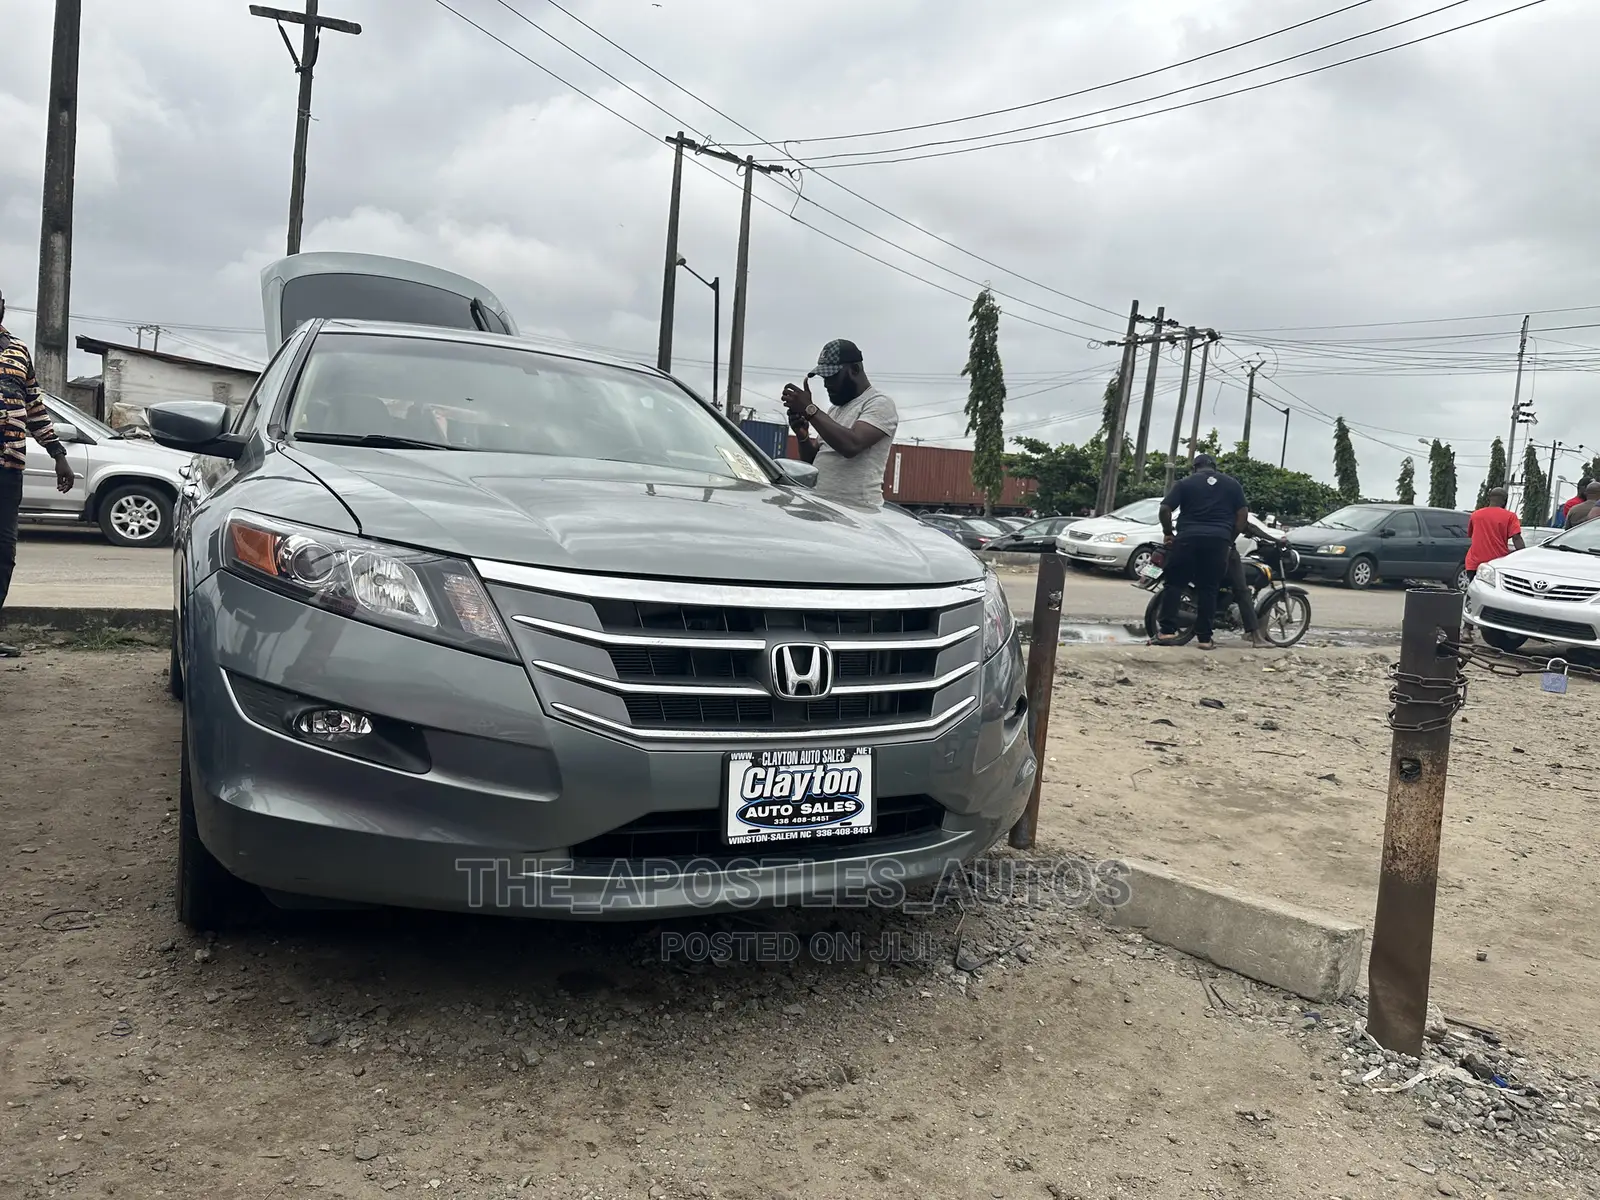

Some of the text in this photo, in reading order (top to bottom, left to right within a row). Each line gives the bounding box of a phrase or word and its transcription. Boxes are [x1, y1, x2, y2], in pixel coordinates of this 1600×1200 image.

[762, 750, 798, 766] CLAYTON
[800, 749, 820, 764] AUTO
[822, 748, 846, 763] SALES
[741, 765, 861, 802] Clayton
[745, 801, 856, 818] AUTO SALES
[729, 832, 798, 845] WINSTON-SALEM
[800, 831, 812, 839] NC
